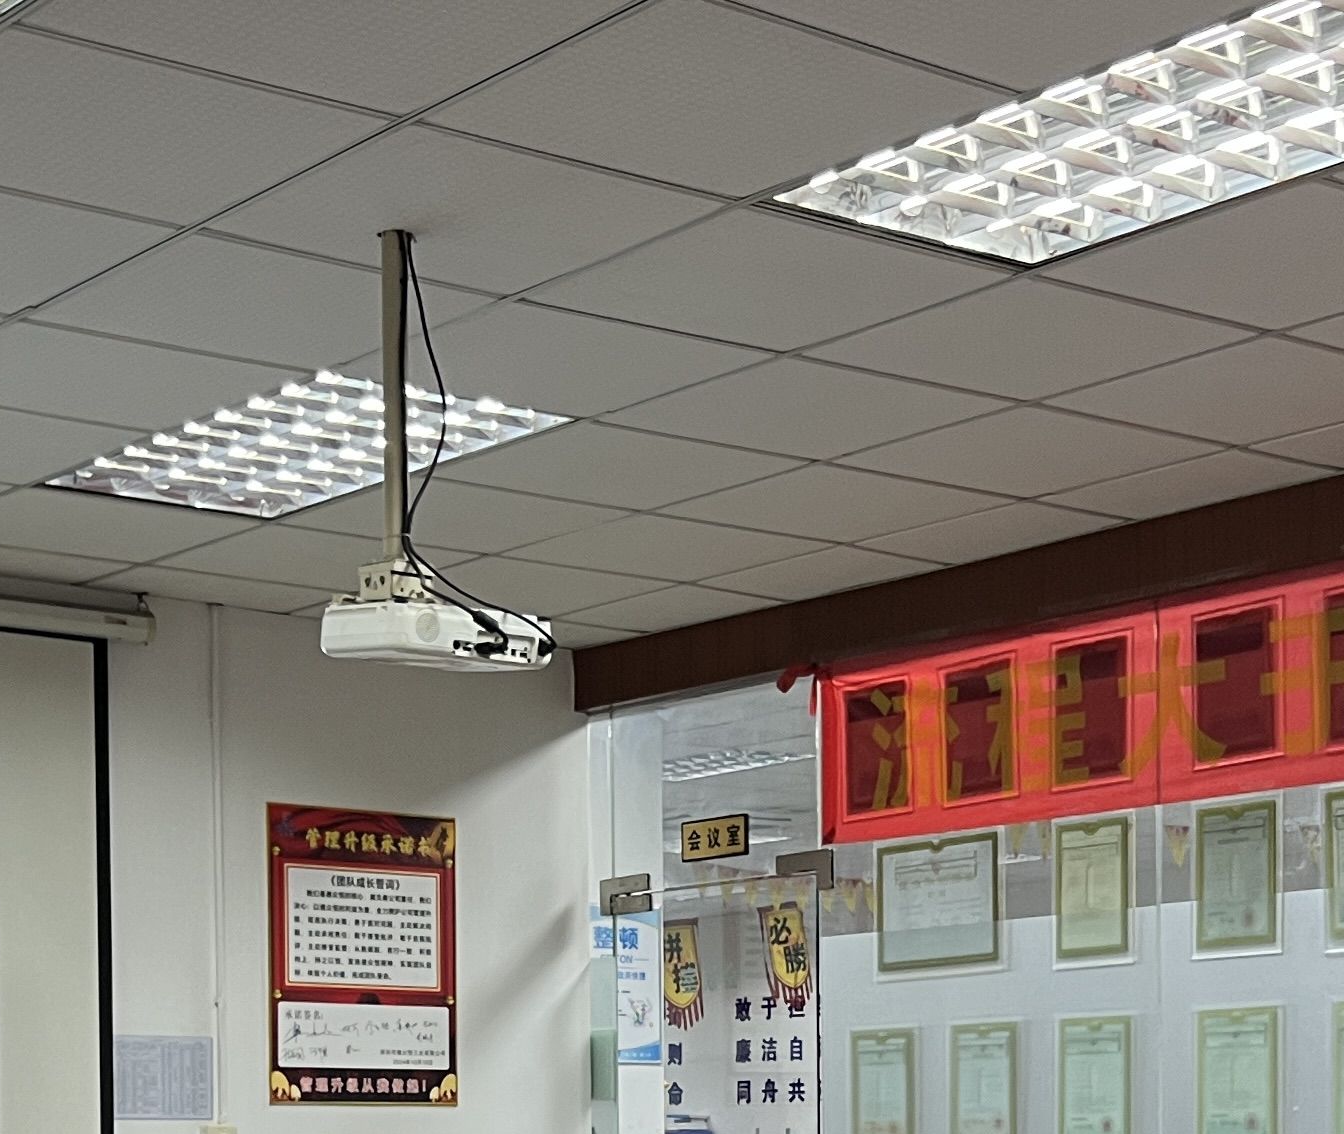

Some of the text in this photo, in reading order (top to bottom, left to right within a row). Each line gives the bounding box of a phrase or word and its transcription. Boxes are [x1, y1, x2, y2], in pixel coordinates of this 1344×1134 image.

[306, 828, 433, 857] 管理升级承诺书
[688, 824, 741, 851] 会议室
[593, 925, 639, 951] 整顿
[735, 1036, 803, 1063] 廉洁自
[736, 1077, 805, 1105] 同舟共
